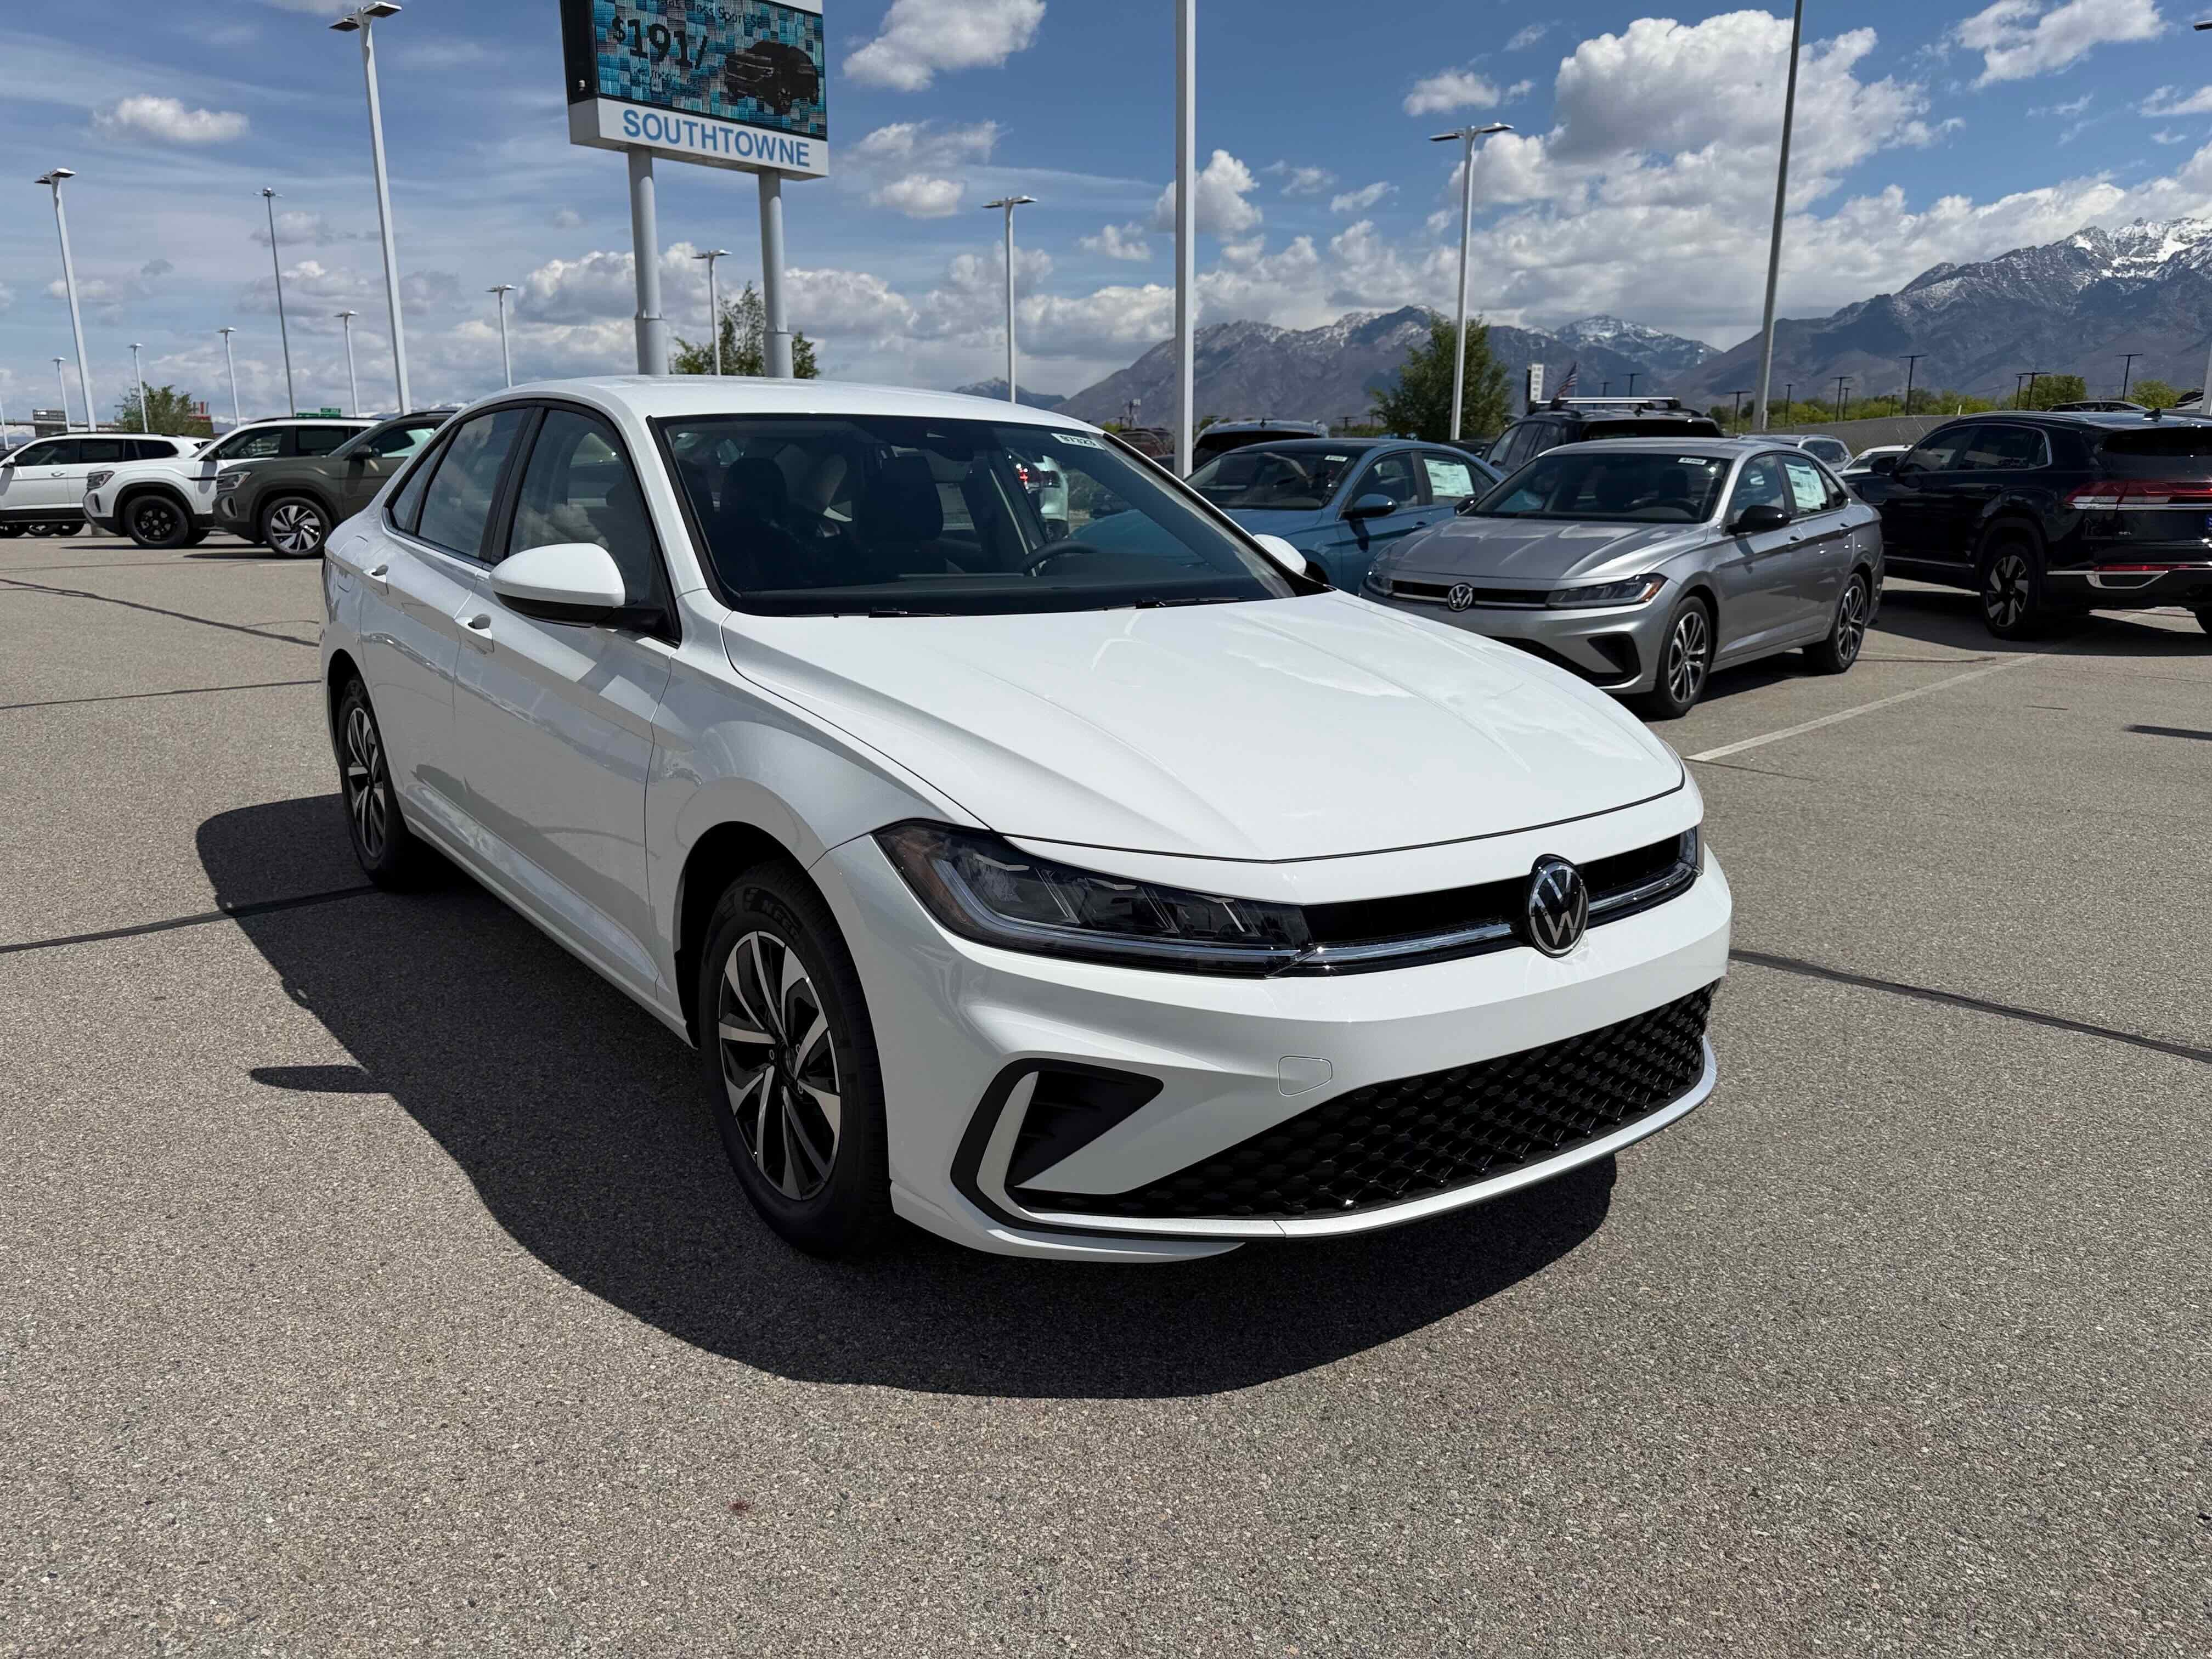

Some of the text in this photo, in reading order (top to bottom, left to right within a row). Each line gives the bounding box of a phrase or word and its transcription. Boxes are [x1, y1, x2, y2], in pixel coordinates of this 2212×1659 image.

[623, 110, 810, 167] SOUTHTOWNE
[1448, 584, 1473, 611] VW
[1530, 861, 1588, 955] VW
